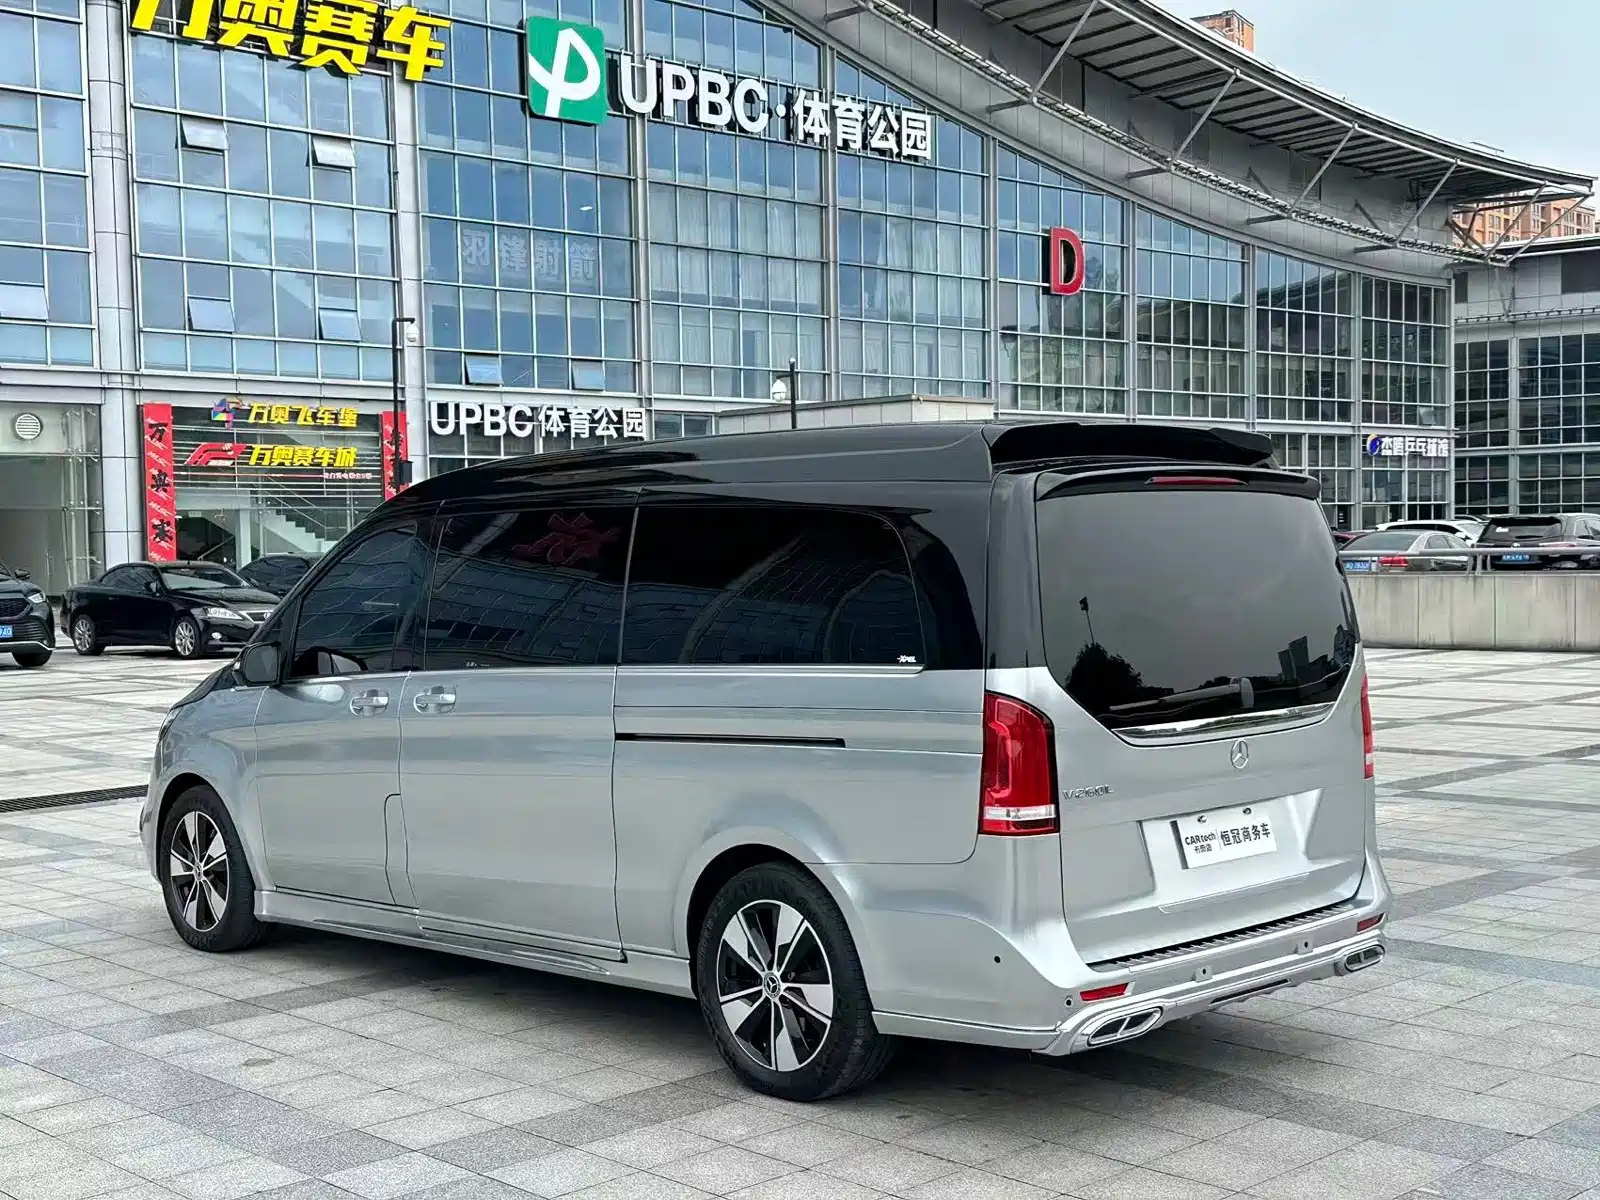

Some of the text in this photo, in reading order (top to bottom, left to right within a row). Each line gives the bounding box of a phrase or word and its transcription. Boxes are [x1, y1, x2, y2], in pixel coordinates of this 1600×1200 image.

[1050, 227, 1085, 296] D
[1220, 822, 1271, 847] 恒冠商务车
